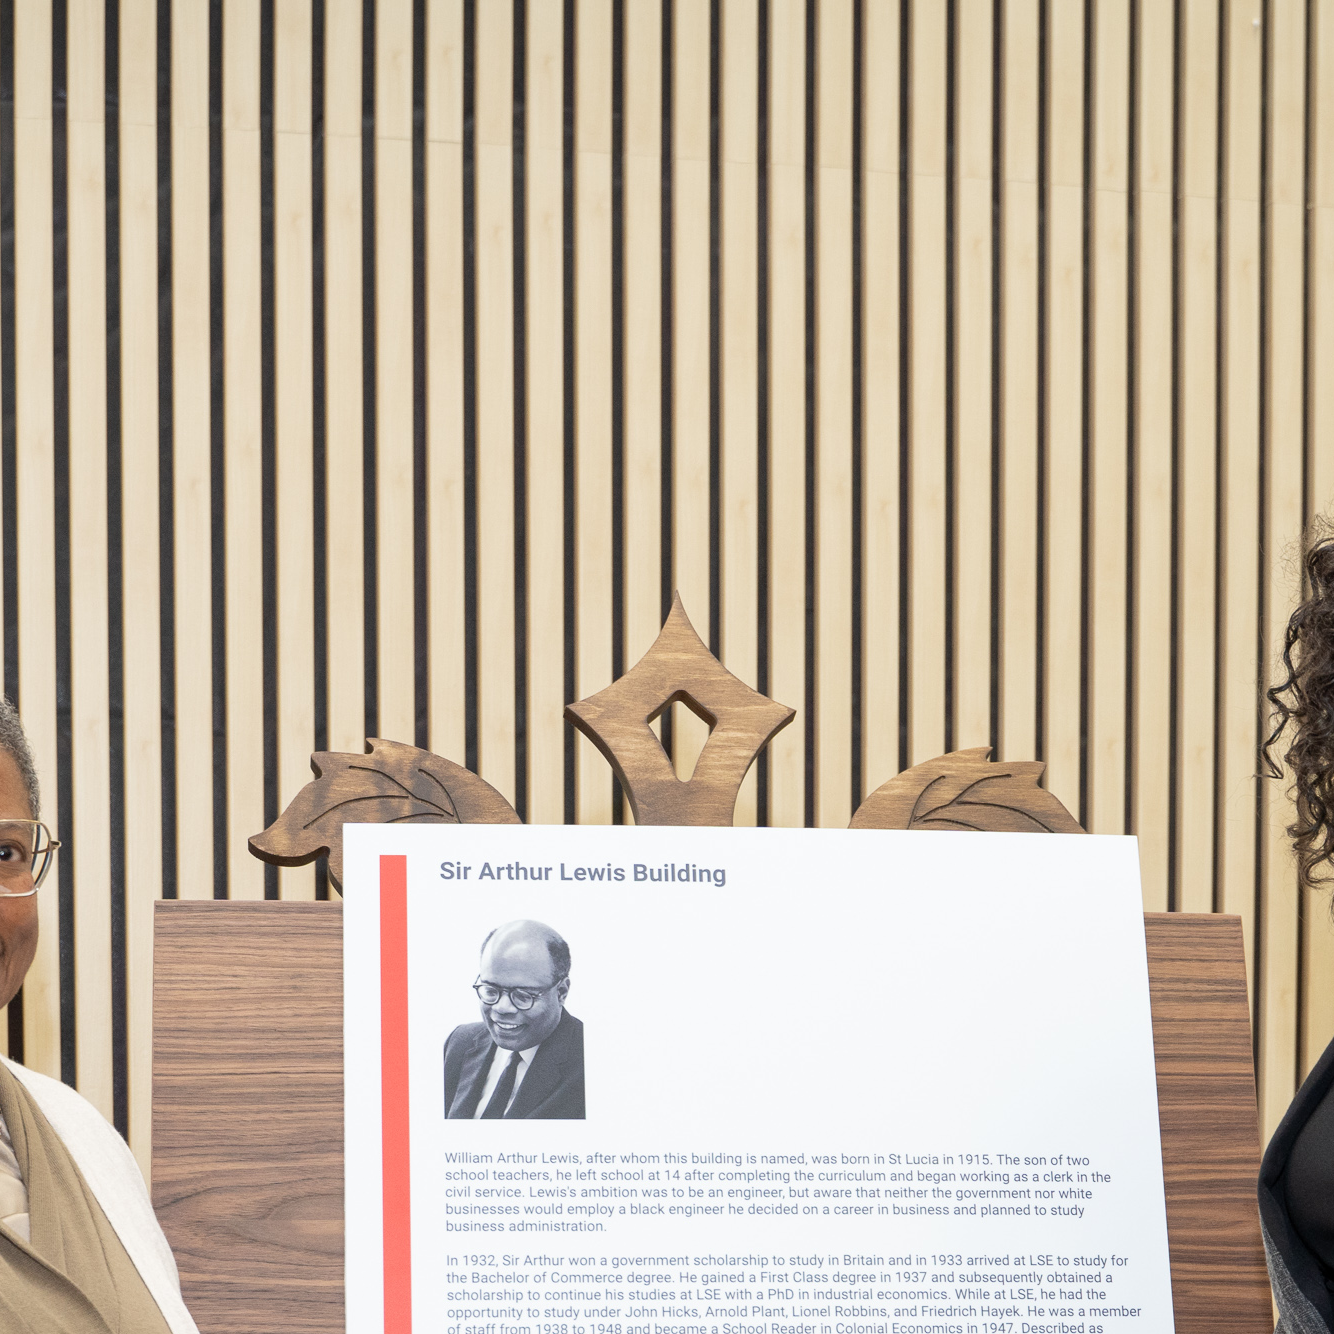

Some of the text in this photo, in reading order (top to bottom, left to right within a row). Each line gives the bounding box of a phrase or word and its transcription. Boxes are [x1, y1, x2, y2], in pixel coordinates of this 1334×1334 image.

[440, 861, 726, 887] Sir Arthur Lewis Building
[444, 1151, 1090, 1168] William Arthur Lewis, after whom this building is named, was born in St Lucia in 1915. The son of two
[445, 1219, 608, 1232] business administration.
[446, 1253, 1129, 1270] In 1932, Sir Arthur won a government scholarship to study in Britain and in 1933 arrived at LSE to study for
